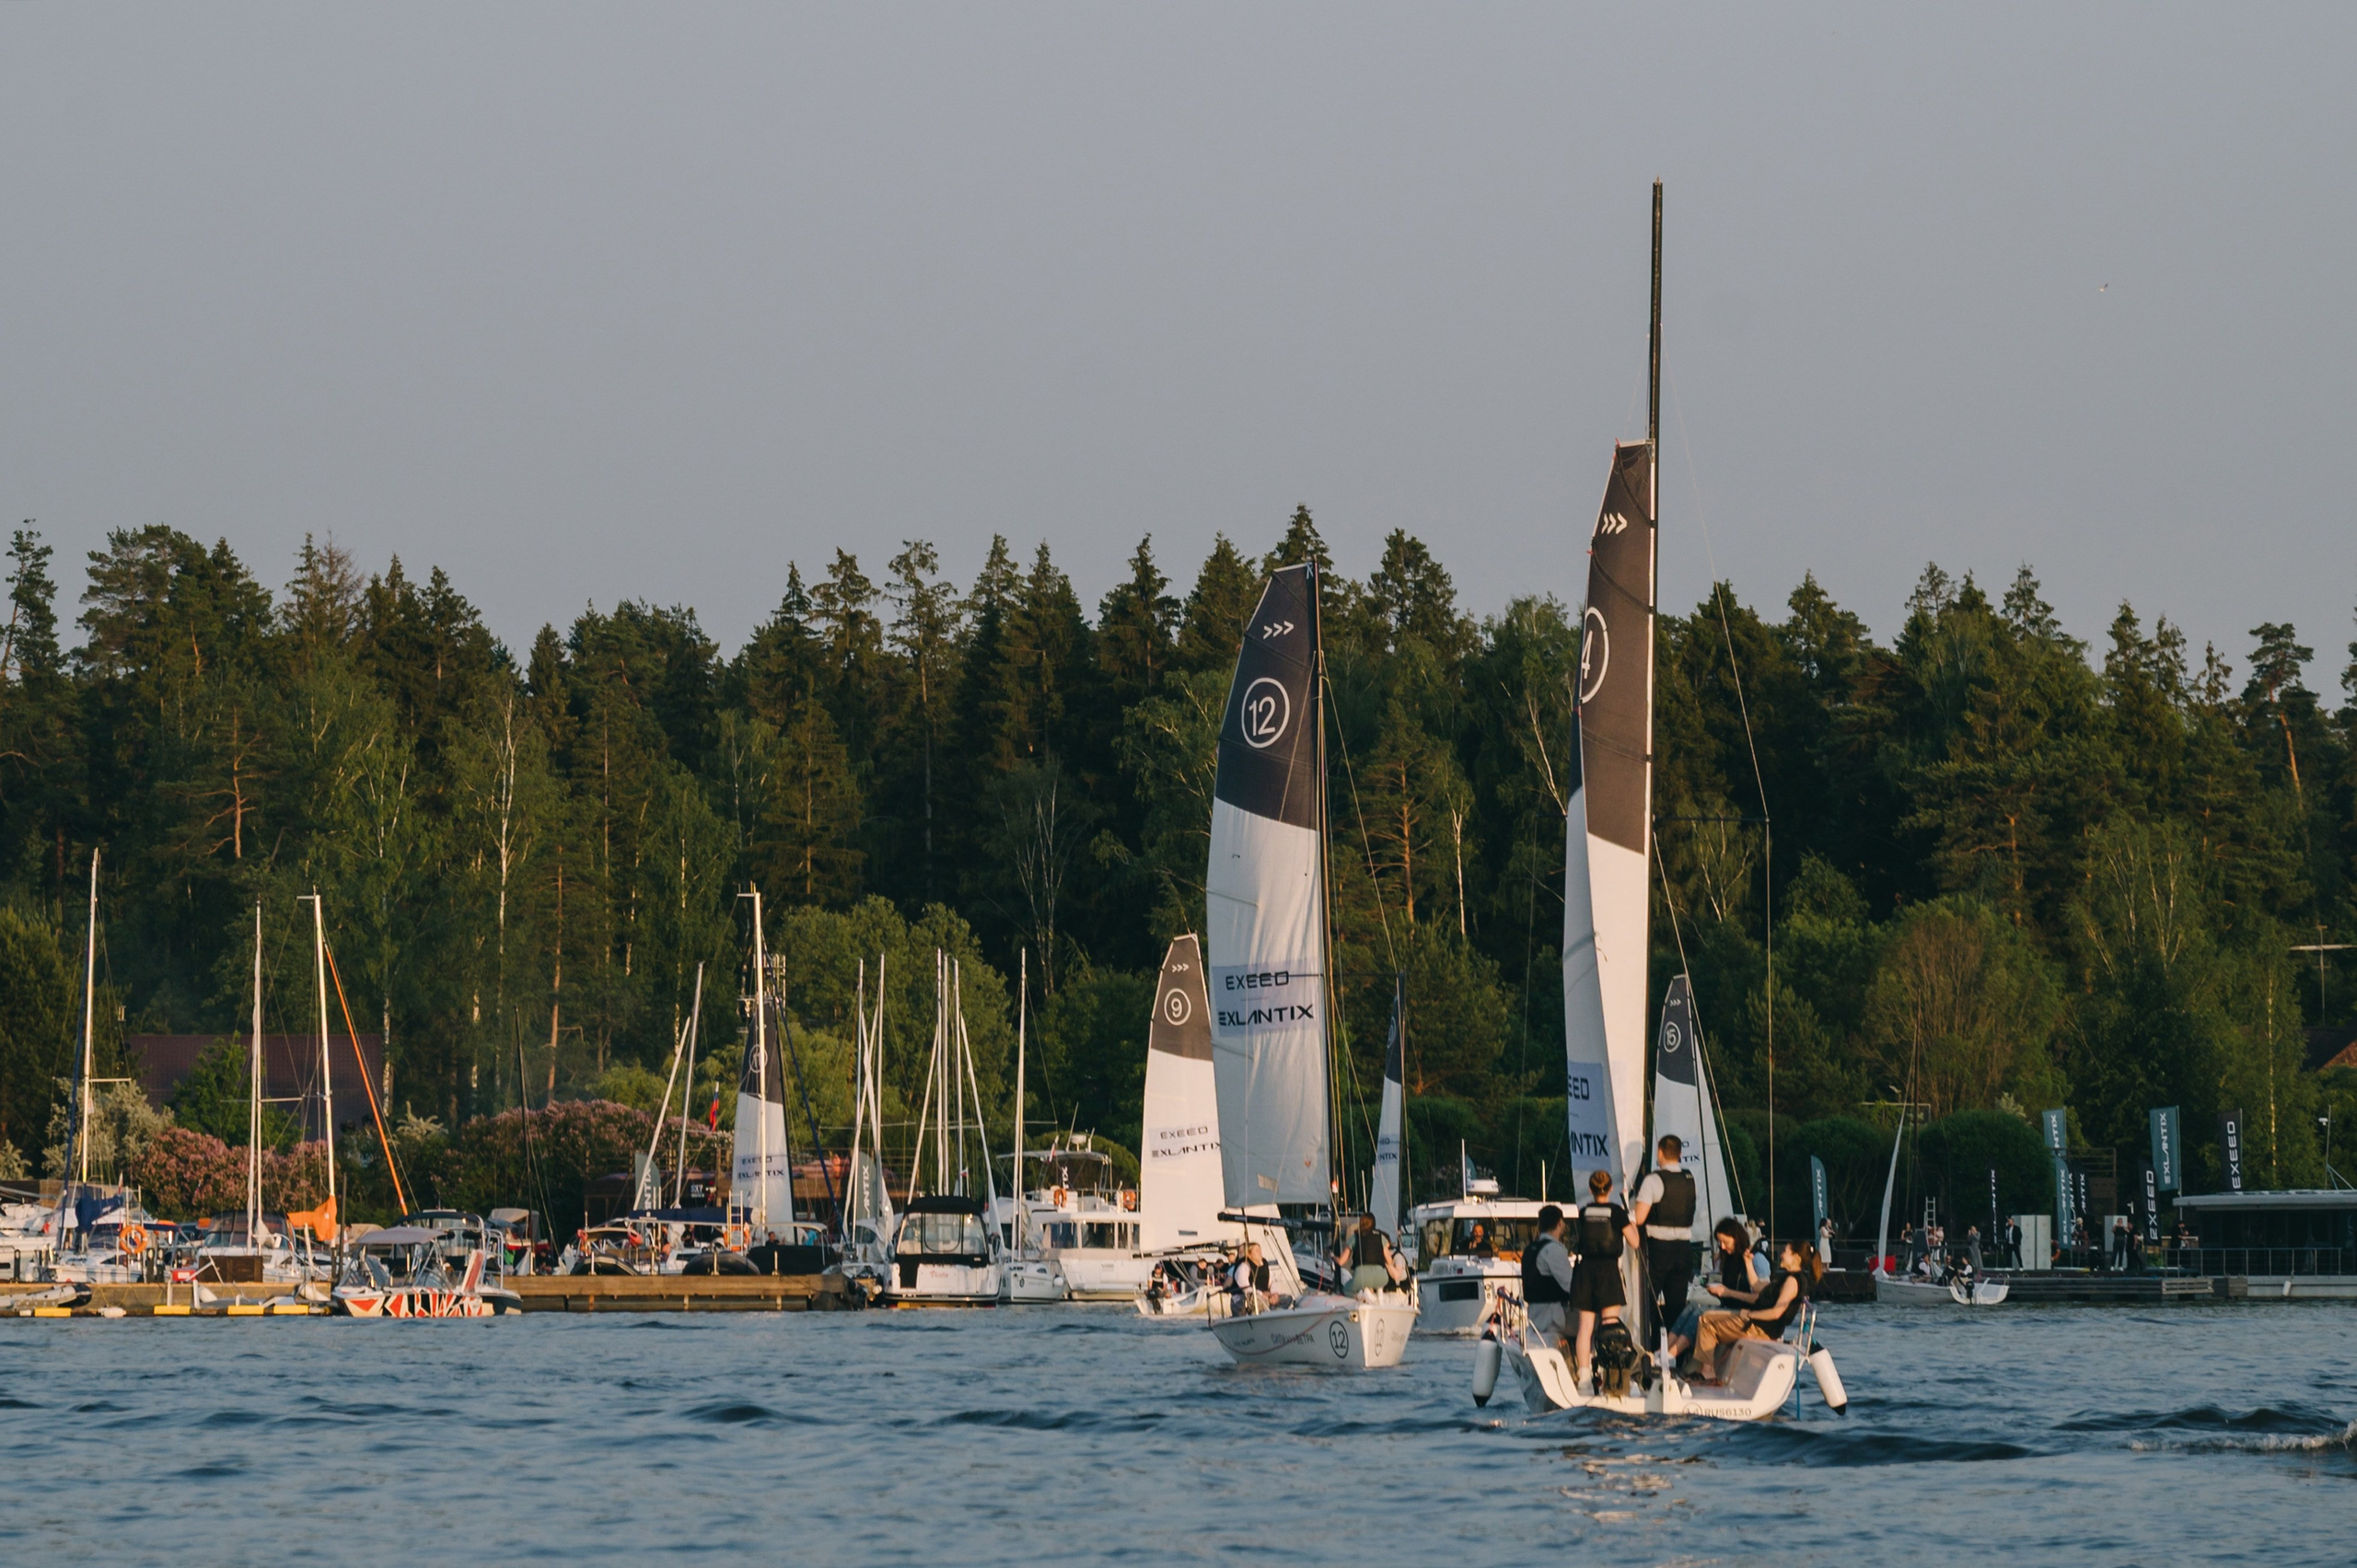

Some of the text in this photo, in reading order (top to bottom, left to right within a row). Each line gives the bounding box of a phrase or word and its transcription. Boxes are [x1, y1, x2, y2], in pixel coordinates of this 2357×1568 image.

[1582, 630, 1594, 679] 4
[1248, 696, 1276, 737] 12
[1225, 970, 1289, 991] EXEED
[1170, 997, 1183, 1018] 9
[1218, 1004, 1315, 1027] EXLANTIX
[1666, 1028, 1677, 1046] 15
[1568, 1075, 1590, 1100] EED
[1160, 1125, 1209, 1140] EXEED
[2159, 1112, 2172, 1186] EXLANTIX
[2226, 1121, 2242, 1190] EXEED
[2145, 1169, 2159, 1240] EXEED
[1332, 1330, 1347, 1350] 12
